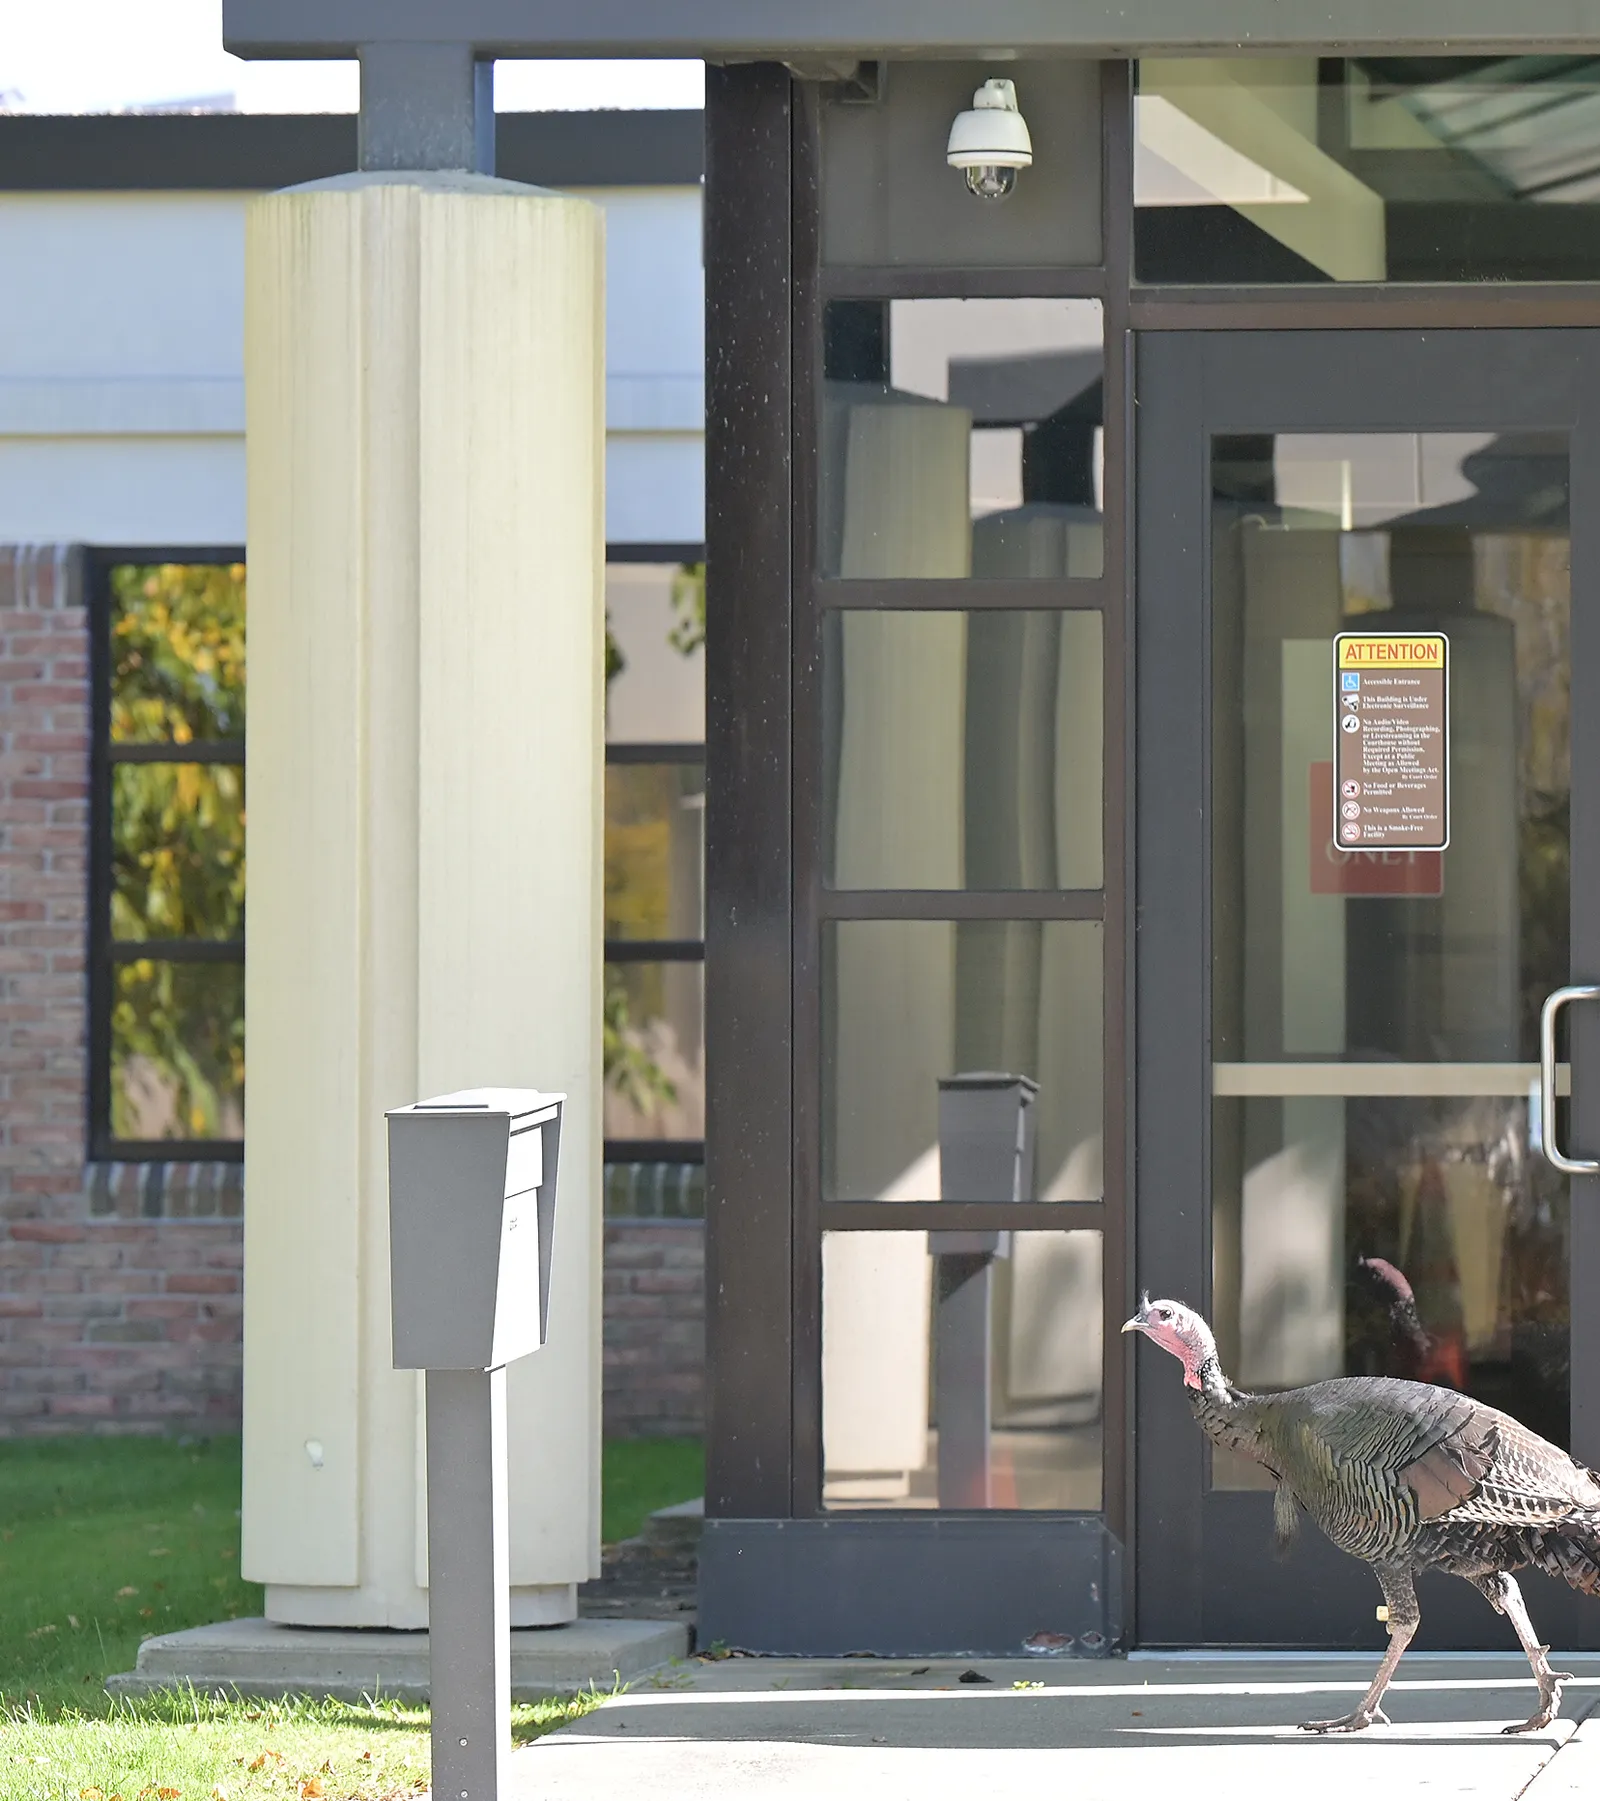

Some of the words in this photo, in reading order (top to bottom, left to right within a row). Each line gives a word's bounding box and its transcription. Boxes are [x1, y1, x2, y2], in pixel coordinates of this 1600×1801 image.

[1345, 643, 1438, 660] ATTENTION
[1376, 696, 1402, 704] Building
[1371, 733, 1412, 741] Livestreaming
[1363, 746, 1390, 754] Required
[1363, 753, 1383, 761] Except
[1363, 760, 1387, 768] Meeting
[1397, 782, 1426, 790] Beverages
[1373, 807, 1400, 815] Weapons
[1363, 832, 1385, 840] Facility
